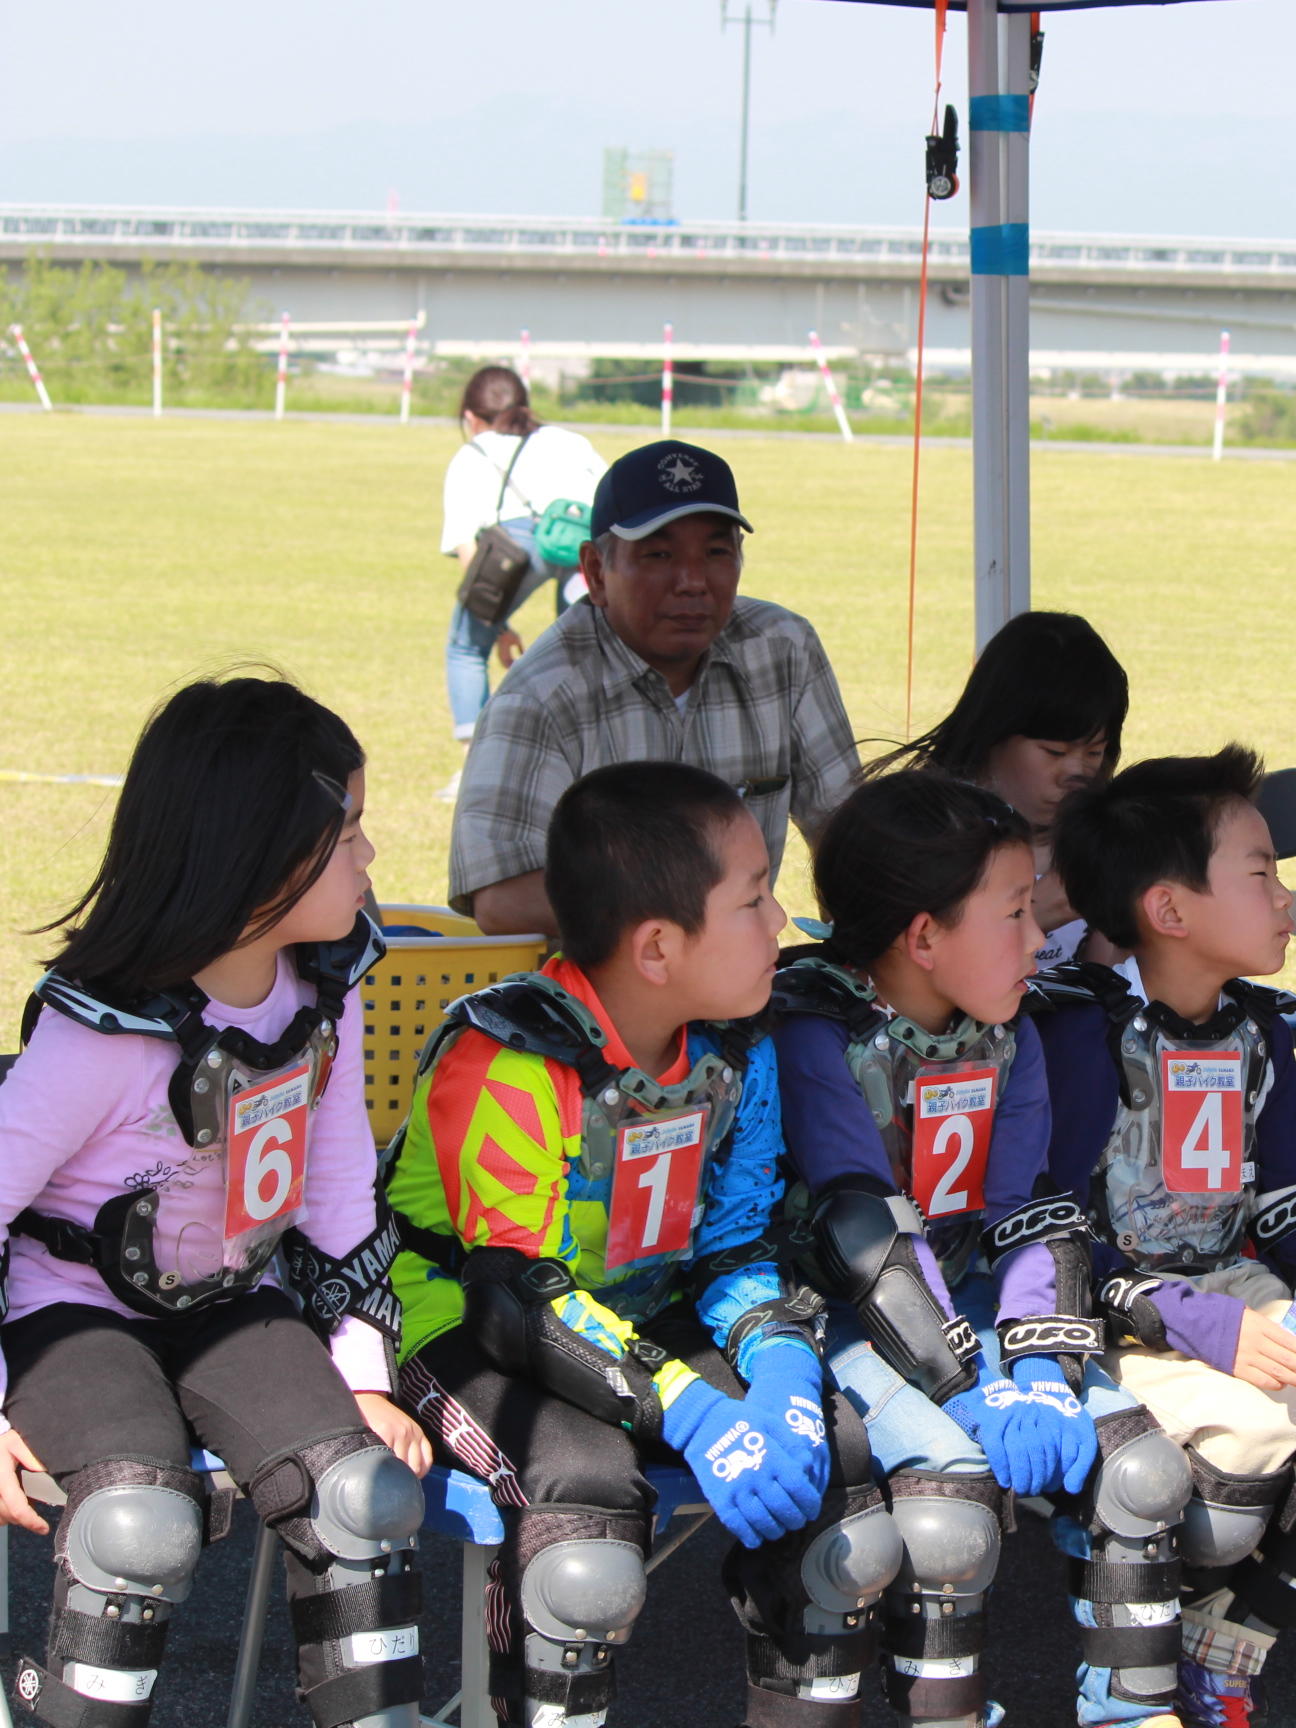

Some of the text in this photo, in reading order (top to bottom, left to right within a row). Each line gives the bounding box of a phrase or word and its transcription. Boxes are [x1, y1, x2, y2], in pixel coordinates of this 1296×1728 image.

[1174, 1075, 1236, 1089] 親子バイク教室
[926, 1093, 986, 1114] 親子バイク教室
[1181, 1092, 1230, 1189] 4
[244, 1117, 293, 1221] 6
[928, 1114, 974, 1216] 2
[638, 1152, 672, 1249] 1
[994, 1201, 1081, 1247] UFO
[1122, 1234, 1133, 1247] S
[164, 1274, 176, 1286] S
[1004, 1321, 1096, 1350] UFO
